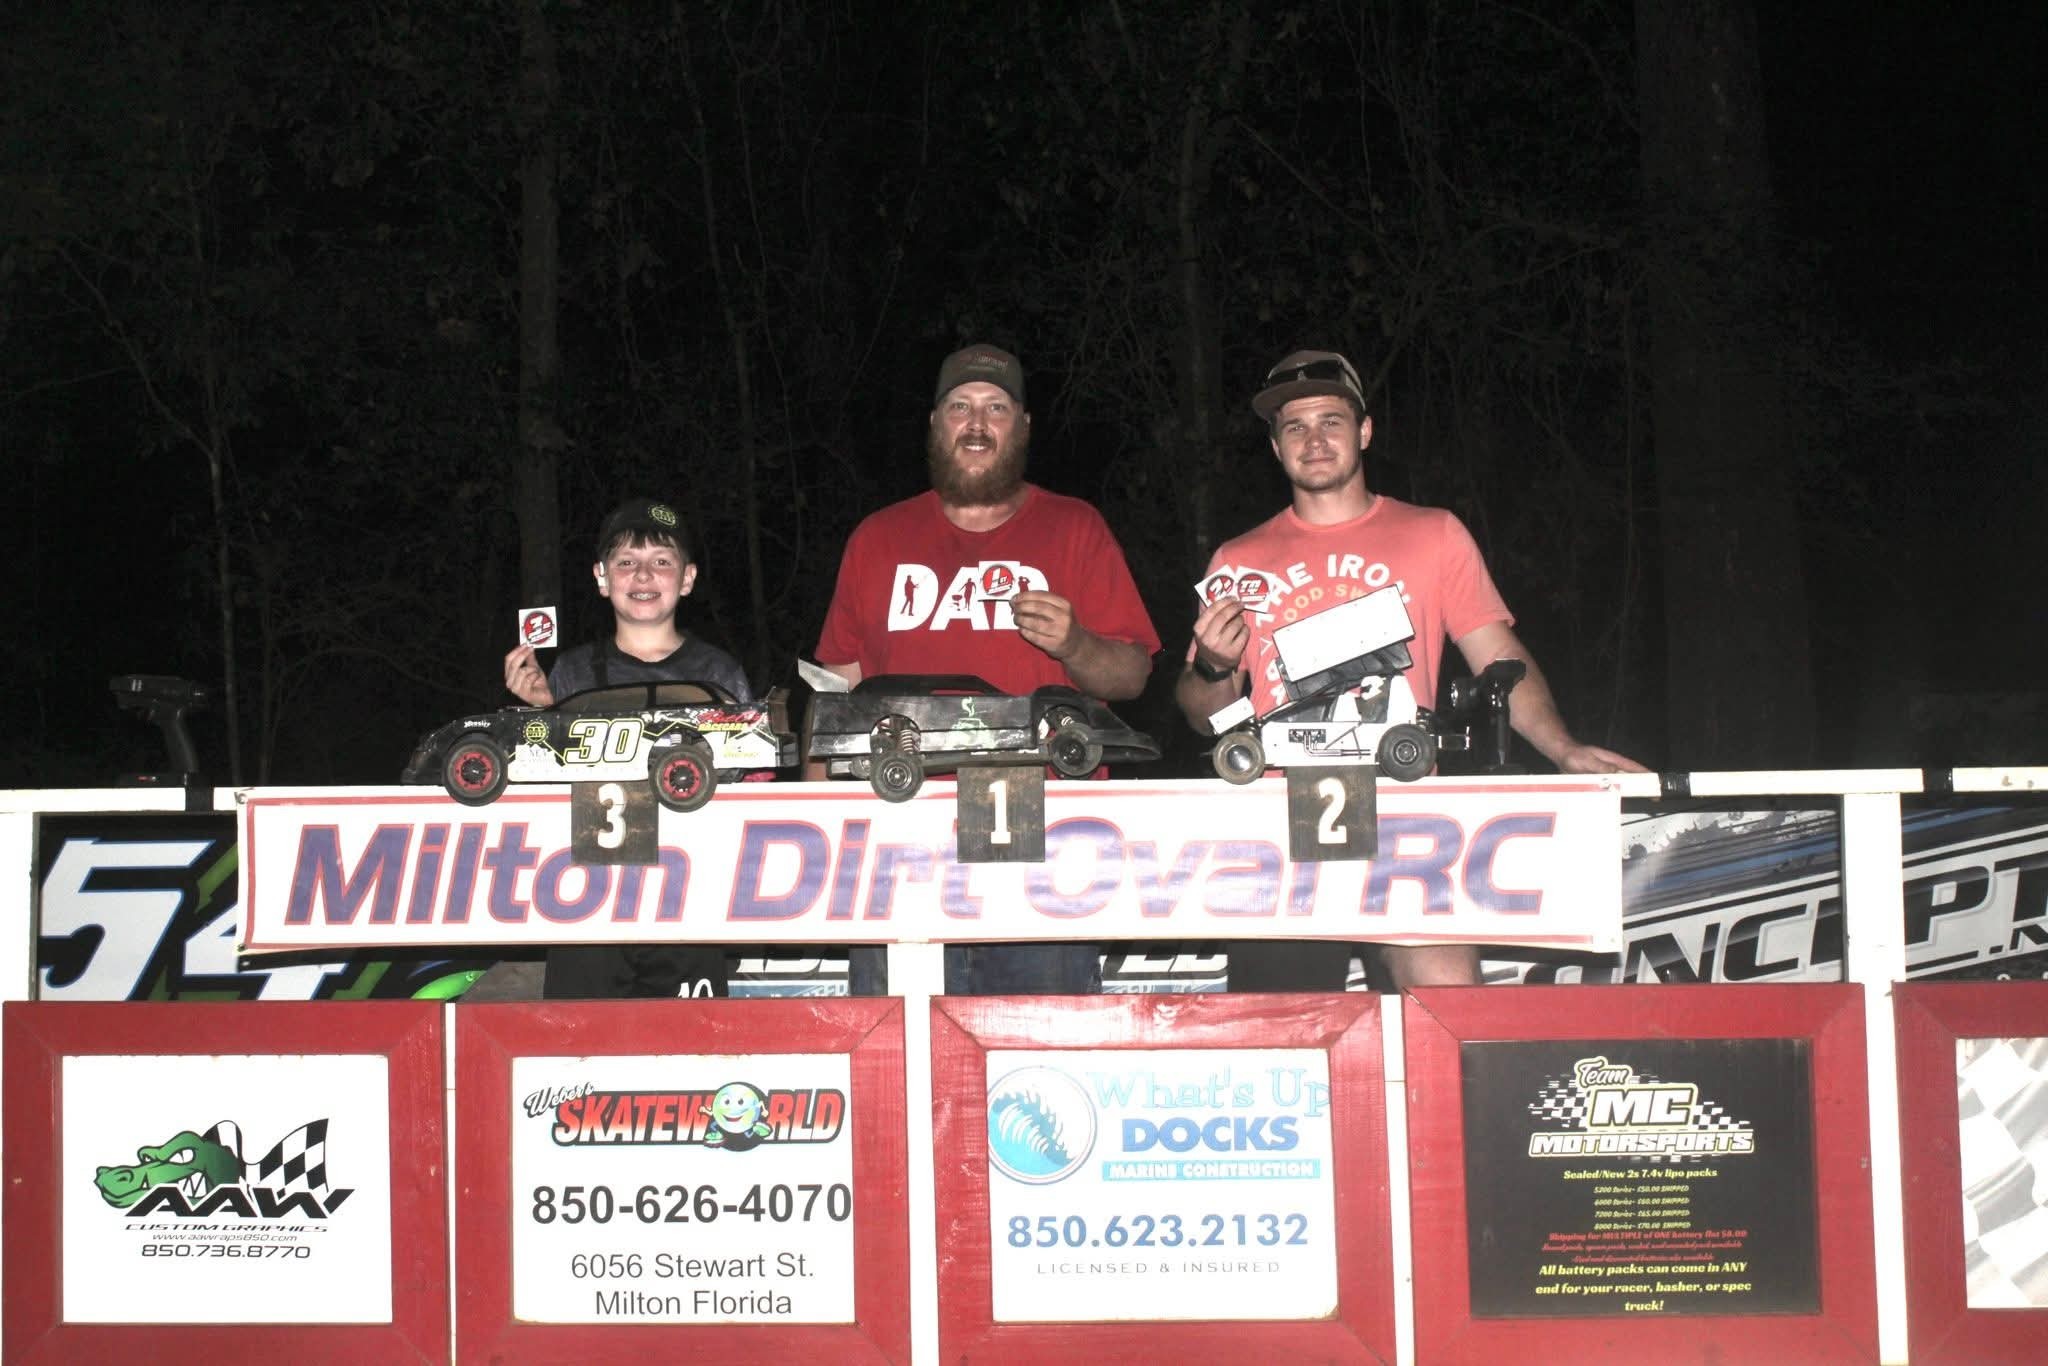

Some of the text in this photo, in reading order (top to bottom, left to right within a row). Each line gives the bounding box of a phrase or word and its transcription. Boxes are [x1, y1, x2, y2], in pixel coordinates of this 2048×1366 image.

[562, 717, 645, 765] 30
[597, 783, 628, 849] 3
[987, 780, 1012, 845] 1
[1318, 781, 1347, 844] 2
[284, 811, 1557, 925] Milton Dirt Oval RC
[1577, 1058, 1631, 1087] Team
[1087, 1065, 1331, 1118] What's Up
[1590, 1087, 1695, 1127] MC
[1121, 1116, 1300, 1153] DOCKS
[1530, 1130, 1755, 1157] MOTORSPORTS
[1110, 1161, 1315, 1179] MARINE CONSTRUCTION
[1563, 1167, 1718, 1180] Sealed/New 2s 7.4v lipo packs
[124, 1185, 356, 1219] AAW
[531, 1183, 852, 1225] 850-626-4070
[123, 1222, 328, 1233] CUSTOM GRAPHICS
[151, 1233, 298, 1244] www.aawraps850.com
[1007, 1213, 1309, 1249] 850.623.2132
[141, 1243, 311, 1260] 850.736.8770
[570, 1252, 816, 1279] 6056 Stewart St.
[1037, 1261, 1281, 1276] LICENSED & INSURED
[1539, 1261, 1748, 1277] All battery packs can come in ANY
[594, 1289, 794, 1316] Milton Florida
[1535, 1281, 1752, 1296] end for your racer, basher, or spec
[1624, 1299, 1665, 1311] truck!
